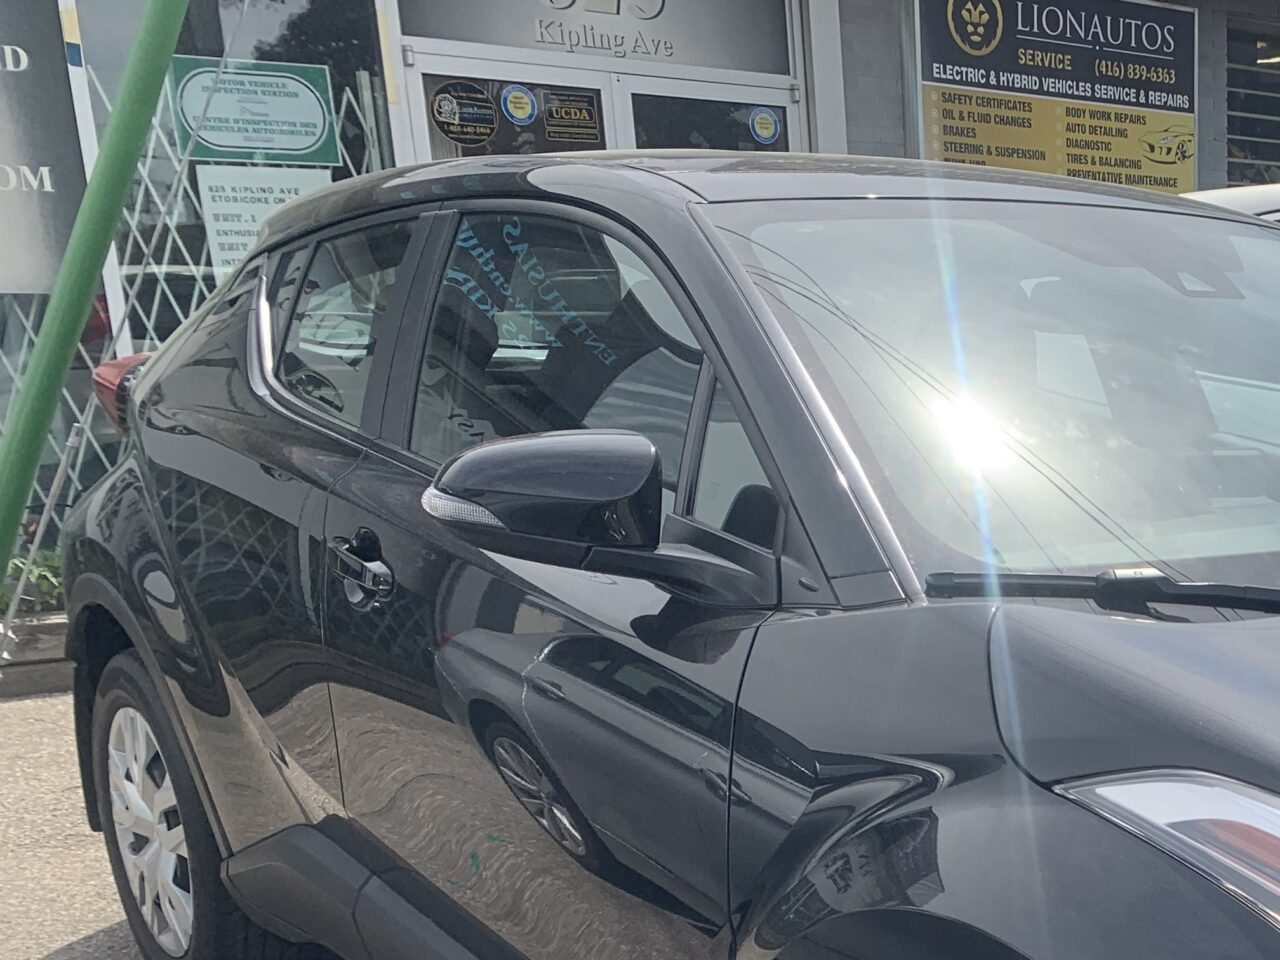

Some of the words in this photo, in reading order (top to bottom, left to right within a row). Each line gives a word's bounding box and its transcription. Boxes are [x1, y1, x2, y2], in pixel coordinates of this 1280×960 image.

[1016, 2, 1175, 52] LIONAUTOS
[535, 19, 626, 58] Kipling
[631, 31, 674, 57] Ave
[0, 45, 28, 71] D
[1018, 48, 1072, 70] SERVICE
[1095, 59, 1124, 79] (416)
[1127, 64, 1176, 84] 839-6363
[248, 80, 288, 90] VEHICLE
[262, 88, 299, 98] STATION
[932, 62, 986, 84] ELECTRIC
[990, 71, 997, 85] &
[1000, 71, 1039, 91] HYBRID
[1042, 78, 1092, 97] VEHICLES
[1094, 84, 1137, 102] SERVICE
[1139, 90, 1146, 103] &
[1149, 90, 1189, 109] REPAIRS
[942, 92, 974, 106] SAFETY
[976, 96, 1032, 113] CERTIFICATES
[192, 116, 230, 124] CNTRE
[300, 121, 318, 129] DES
[551, 107, 590, 120] UCDA
[942, 108, 956, 120] OIL
[958, 110, 964, 121] &
[968, 112, 992, 124] FLUID
[994, 114, 1032, 128] CHANGES
[1066, 106, 1086, 119] BODY
[1088, 110, 1112, 122] WORK
[1114, 113, 1146, 126] REPAIRS
[942, 124, 976, 138] BRAKES
[1066, 122, 1086, 134] AUTO
[1088, 124, 1128, 138] DETAILING
[944, 142, 984, 156] STEERING
[986, 145, 992, 156] &
[994, 146, 1046, 161] SUSPENSION
[1066, 138, 1112, 152] DIAGNOSTIC
[1066, 153, 1088, 166] TIRES
[1090, 156, 1096, 166] &
[1098, 156, 1142, 170] BALANCING
[1066, 168, 1122, 184] PREVENTATIVE
[1124, 174, 1178, 188] MAINTENANCE
[211, 194, 270, 204] ETOBICOKE
[231, 186, 274, 194] KIPLING
